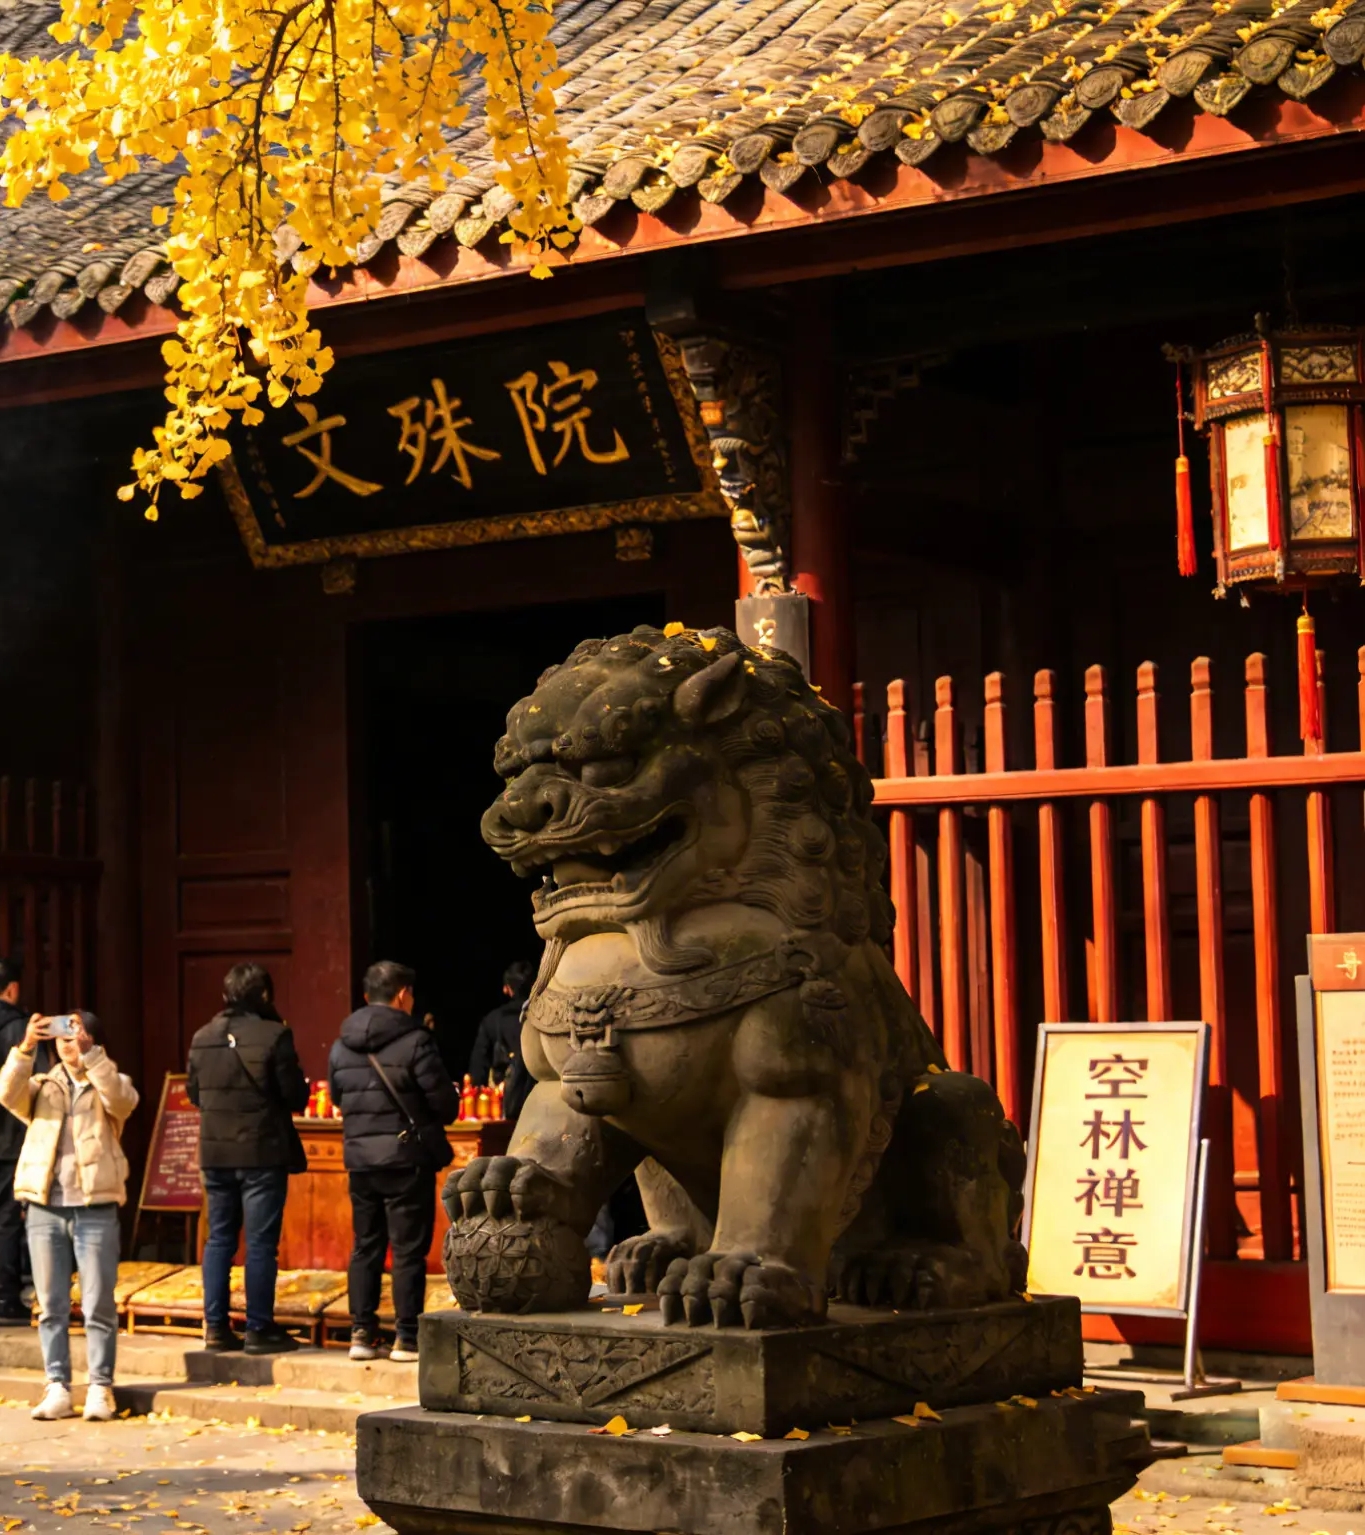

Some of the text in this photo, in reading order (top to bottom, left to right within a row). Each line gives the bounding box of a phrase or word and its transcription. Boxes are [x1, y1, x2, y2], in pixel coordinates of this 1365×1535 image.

[282, 361, 629, 497] 文殊院
[1072, 1054, 1149, 1280] 空林禅意
